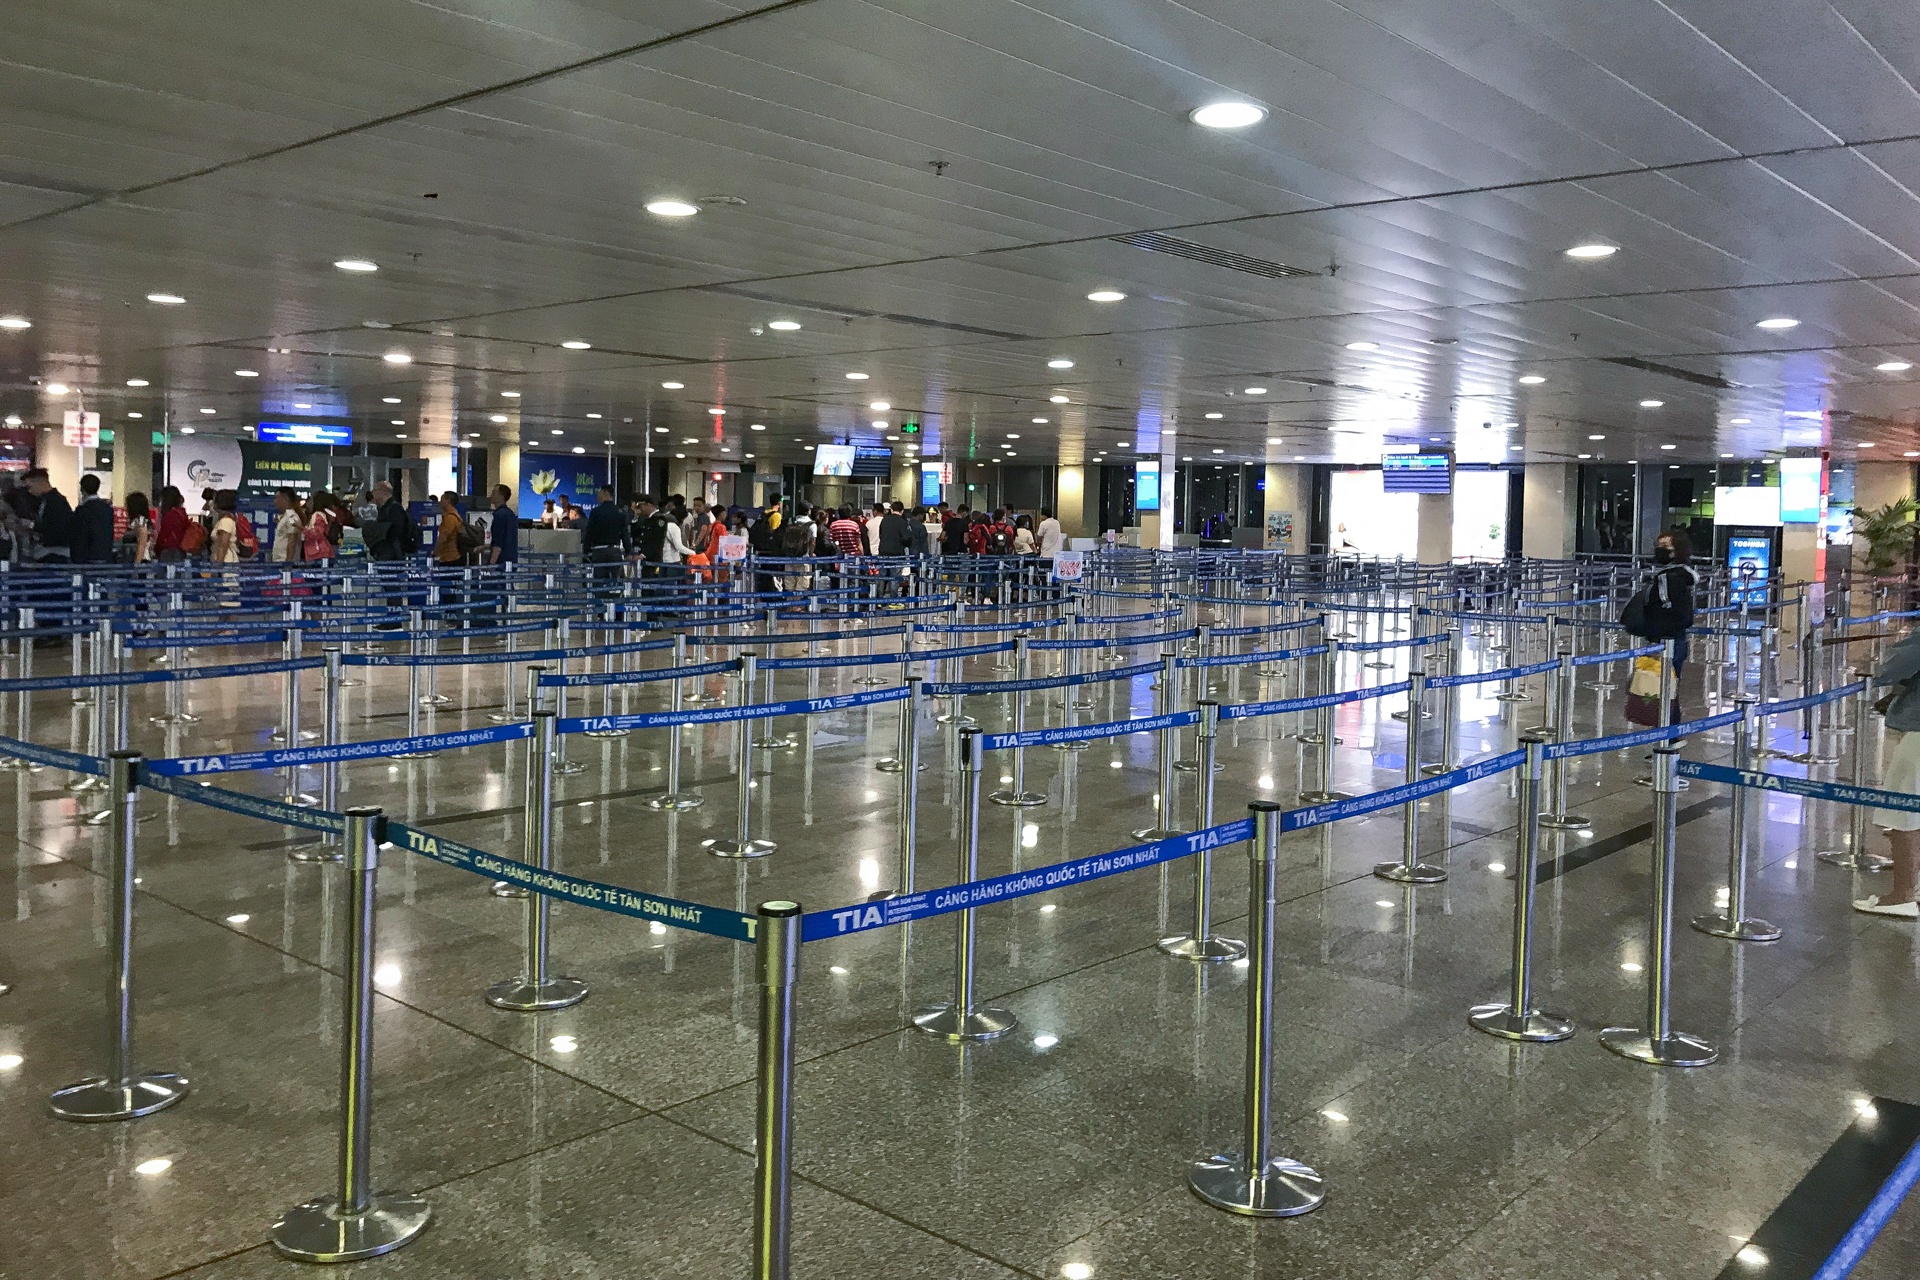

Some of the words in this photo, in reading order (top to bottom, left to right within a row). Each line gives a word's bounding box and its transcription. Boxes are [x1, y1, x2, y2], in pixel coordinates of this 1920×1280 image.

[1733, 540, 1765, 548] TOSHIBA
[565, 648, 585, 656] TIA
[365, 655, 389, 664] TIA
[1182, 658, 1195, 666] TIA
[566, 676, 590, 684] TIA
[1082, 673, 1098, 682] TIA
[1431, 679, 1443, 687] TIA
[931, 684, 950, 693] TIA
[1357, 690, 1369, 699] TIA
[808, 699, 832, 710] TIA
[1188, 712, 1199, 722] TI
[1230, 706, 1246, 716] TIA
[580, 718, 611, 730] TIA
[1083, 727, 1104, 737] KHÔNG
[1123, 721, 1131, 731] TẾ
[1677, 724, 1690, 734] TIA
[993, 734, 1018, 747] TIA
[340, 744, 377, 757] KHÔNG
[412, 739, 423, 749] TẾ
[1548, 745, 1566, 757] TIA
[178, 757, 224, 773] TIA
[1679, 764, 1701, 776] HẤT
[1467, 765, 1482, 780] TIA
[150, 772, 171, 789] TIA
[1739, 771, 1782, 790] TIA
[1833, 787, 1856, 799] TAN
[1859, 791, 1886, 803] SON
[1294, 809, 1317, 827] TIA
[407, 831, 439, 856] TIA
[1187, 831, 1219, 852] TIA
[935, 890, 968, 908] CẢNG
[1005, 875, 1043, 893] KHÔNG
[1046, 867, 1076, 885] QUỐC
[1078, 860, 1090, 877] TẾ
[1091, 857, 1111, 873] TÂN
[1113, 854, 1133, 869] SƠN
[1135, 845, 1160, 862] NHẤT
[475, 854, 502, 874] CẢNG
[533, 874, 570, 893] KHÔNG
[571, 882, 602, 900] QUỐC
[604, 889, 617, 904] TẾ
[619, 891, 641, 910] TÂN
[643, 899, 668, 916] SƠN
[671, 905, 702, 923] NHẤT
[888, 902, 929, 915] INTERNATIONAL
[832, 905, 883, 932] TIA
